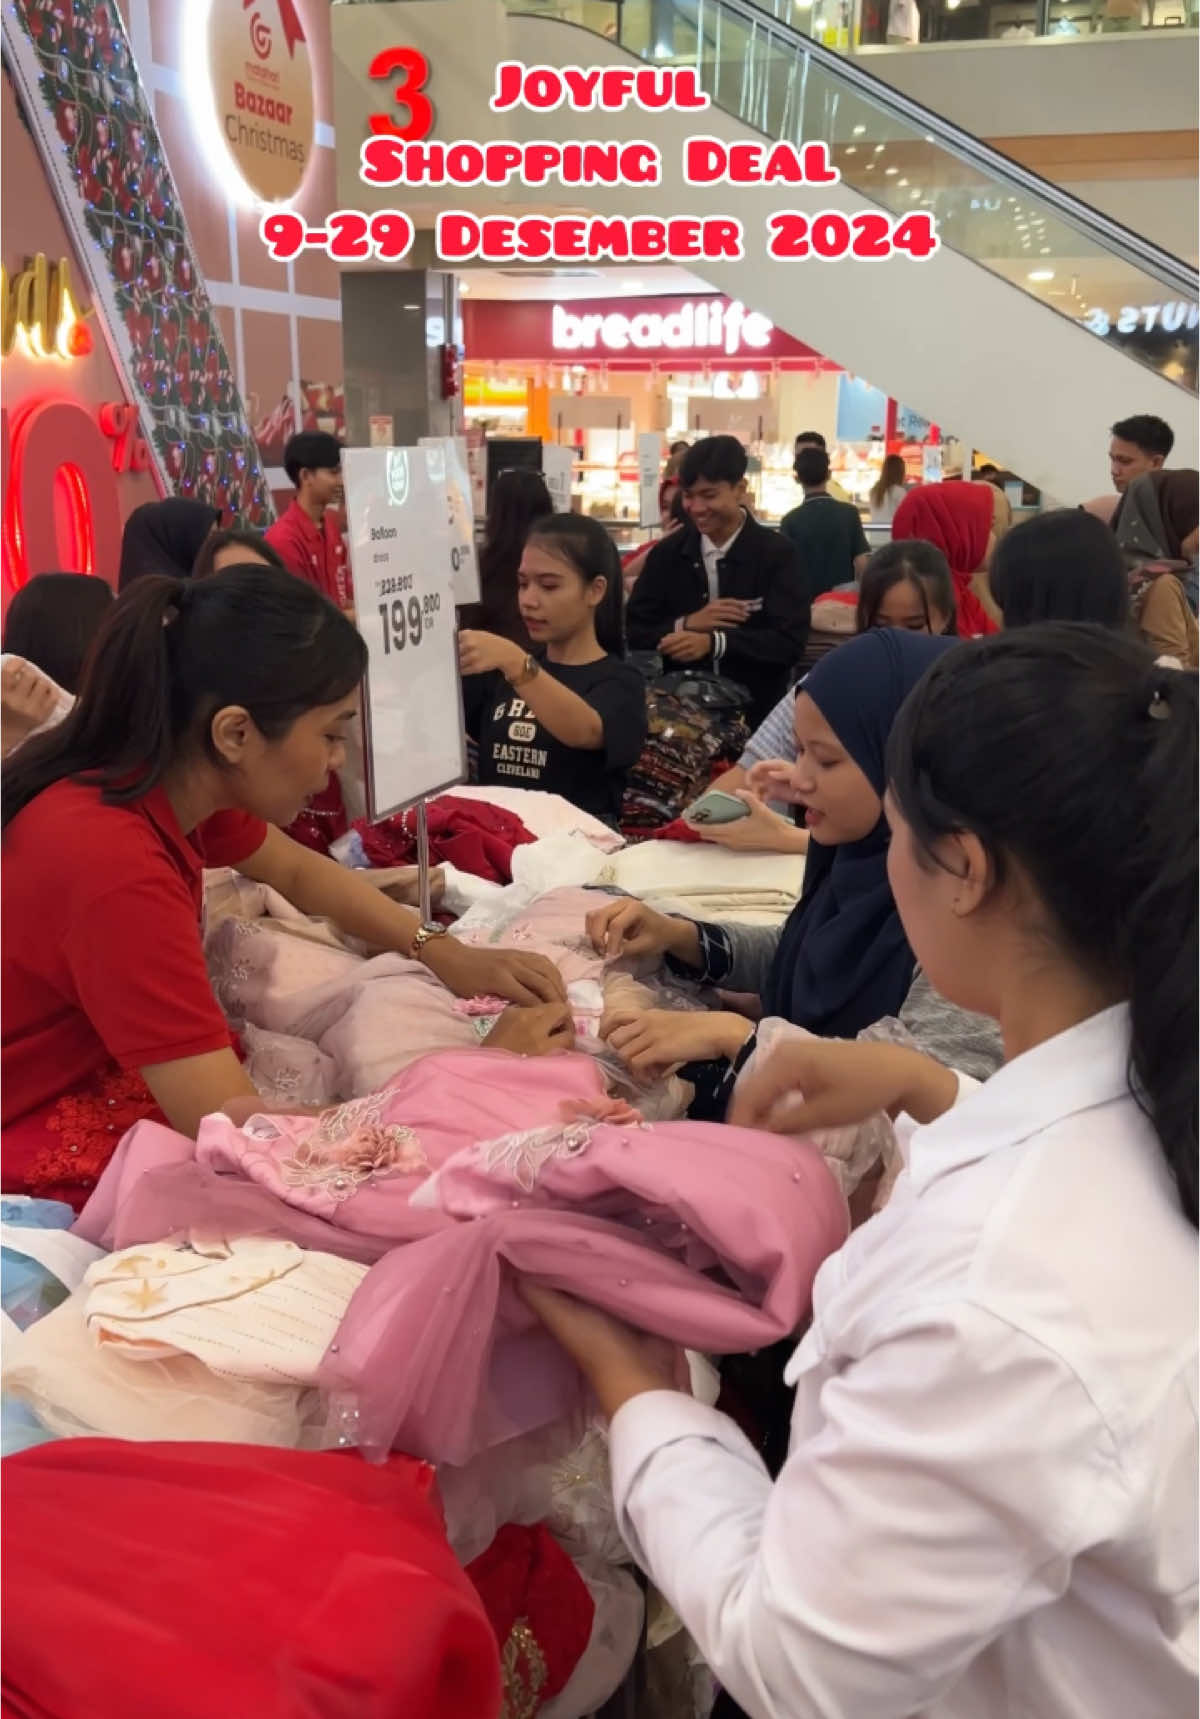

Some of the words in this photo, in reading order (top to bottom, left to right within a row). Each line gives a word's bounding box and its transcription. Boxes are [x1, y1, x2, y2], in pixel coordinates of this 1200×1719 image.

[233, 80, 294, 125] Bazaar
[368, 46, 434, 142] 3
[224, 113, 306, 163] Christmas
[552, 299, 774, 355] breadlife
[2, 398, 151, 592] 0%
[493, 742, 549, 768] EASTERN
